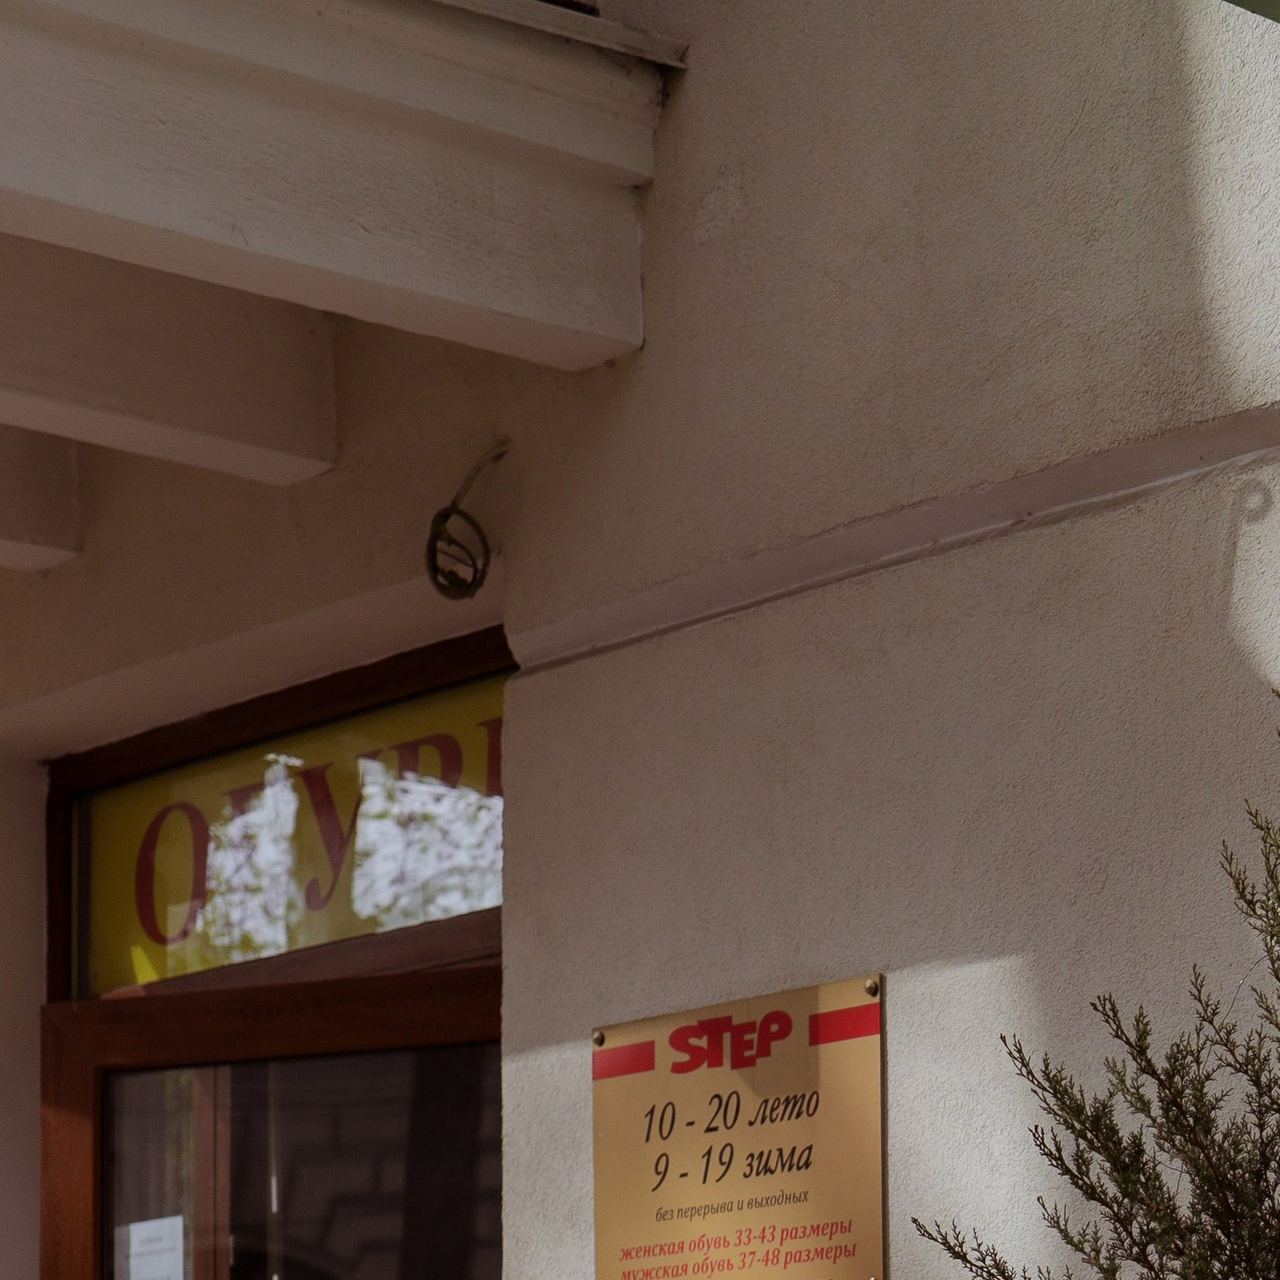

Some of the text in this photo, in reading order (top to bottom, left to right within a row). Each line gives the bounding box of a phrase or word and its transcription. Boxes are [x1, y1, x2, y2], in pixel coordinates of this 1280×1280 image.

[668, 1010, 793, 1074] STEP
[644, 1090, 820, 1143] 10 - 20 лето
[651, 1152, 670, 1192] 9
[701, 1142, 734, 1185] 19
[742, 1143, 814, 1179] зима
[655, 1189, 810, 1222] без перерыва и выходных
[619, 1219, 853, 1261] женская обувь 33-43 размеры
[692, 1256, 734, 1279] обувь
[738, 1247, 780, 1270] 37-48
[783, 1243, 857, 1270] размеры
